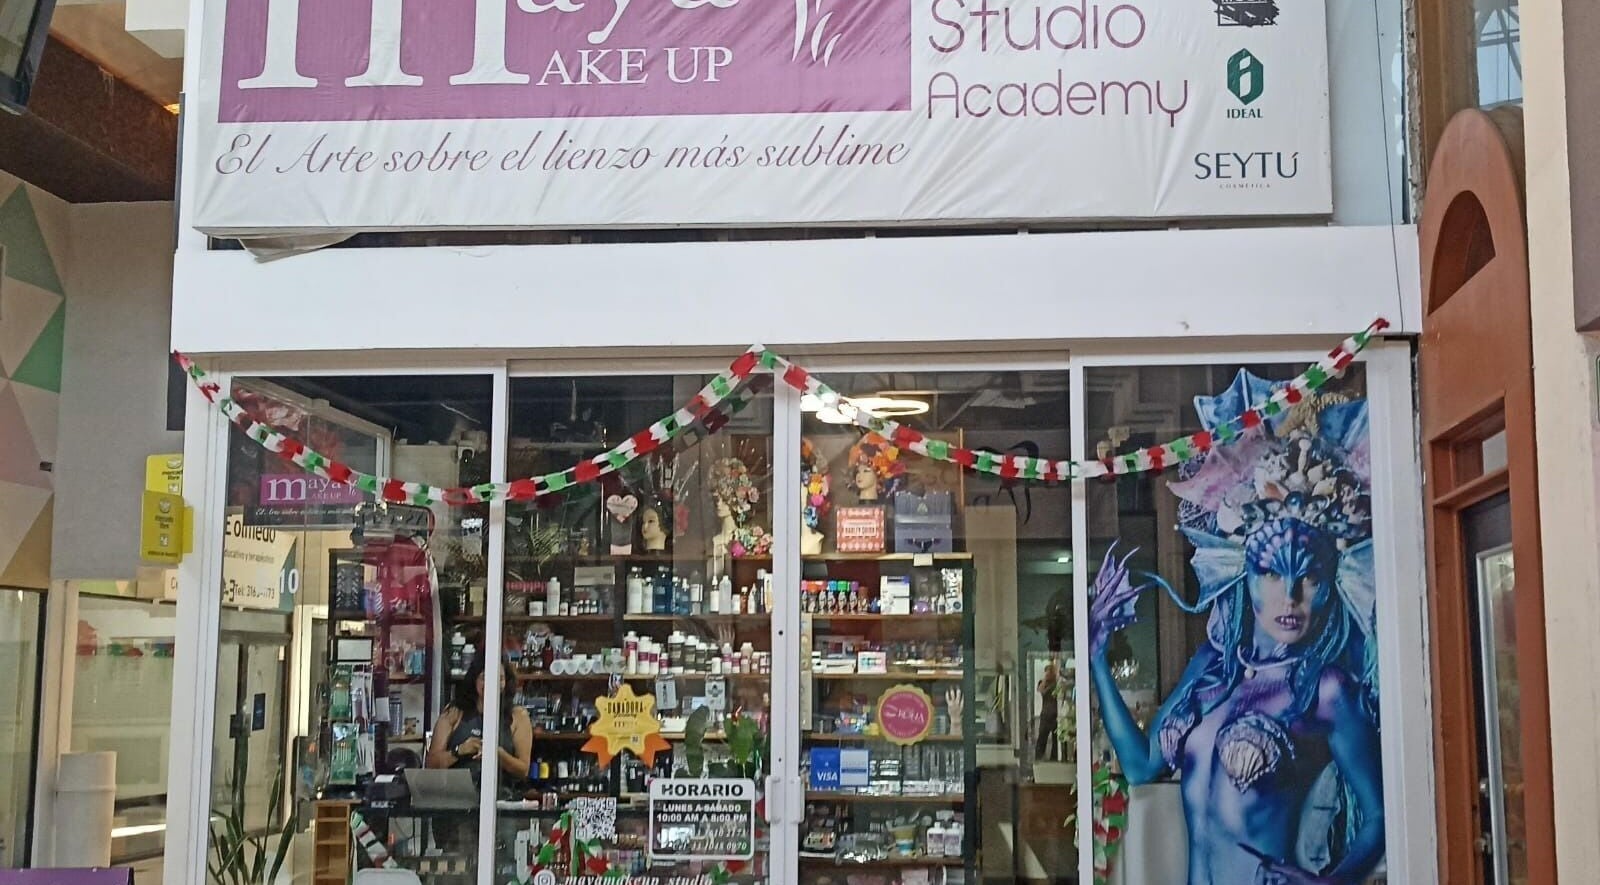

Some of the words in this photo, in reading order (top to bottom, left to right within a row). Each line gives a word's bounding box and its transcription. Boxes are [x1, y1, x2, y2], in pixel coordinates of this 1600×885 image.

[928, 0, 1146, 53] Studio
[536, 48, 648, 86] AKE
[663, 46, 733, 83] UP
[927, 69, 1188, 128] Academy
[1226, 109, 1264, 119] IDEAL
[215, 133, 273, 175] El
[275, 133, 377, 174] Arte
[383, 132, 492, 173] sobre
[501, 130, 543, 171] el
[542, 130, 656, 170] lienzo
[664, 134, 749, 169] más
[757, 124, 911, 167] sublime
[1194, 152, 1299, 179] SEYTÚ
[279, 568, 299, 594] 10
[816, 771, 838, 782] VISA
[661, 783, 744, 797] HORARIO
[656, 813, 682, 823] 10:00
[684, 813, 699, 823] AM
[701, 813, 709, 823] A
[710, 813, 731, 823] 8:00
[733, 813, 748, 823] PM
[662, 803, 693, 813] LUNES
